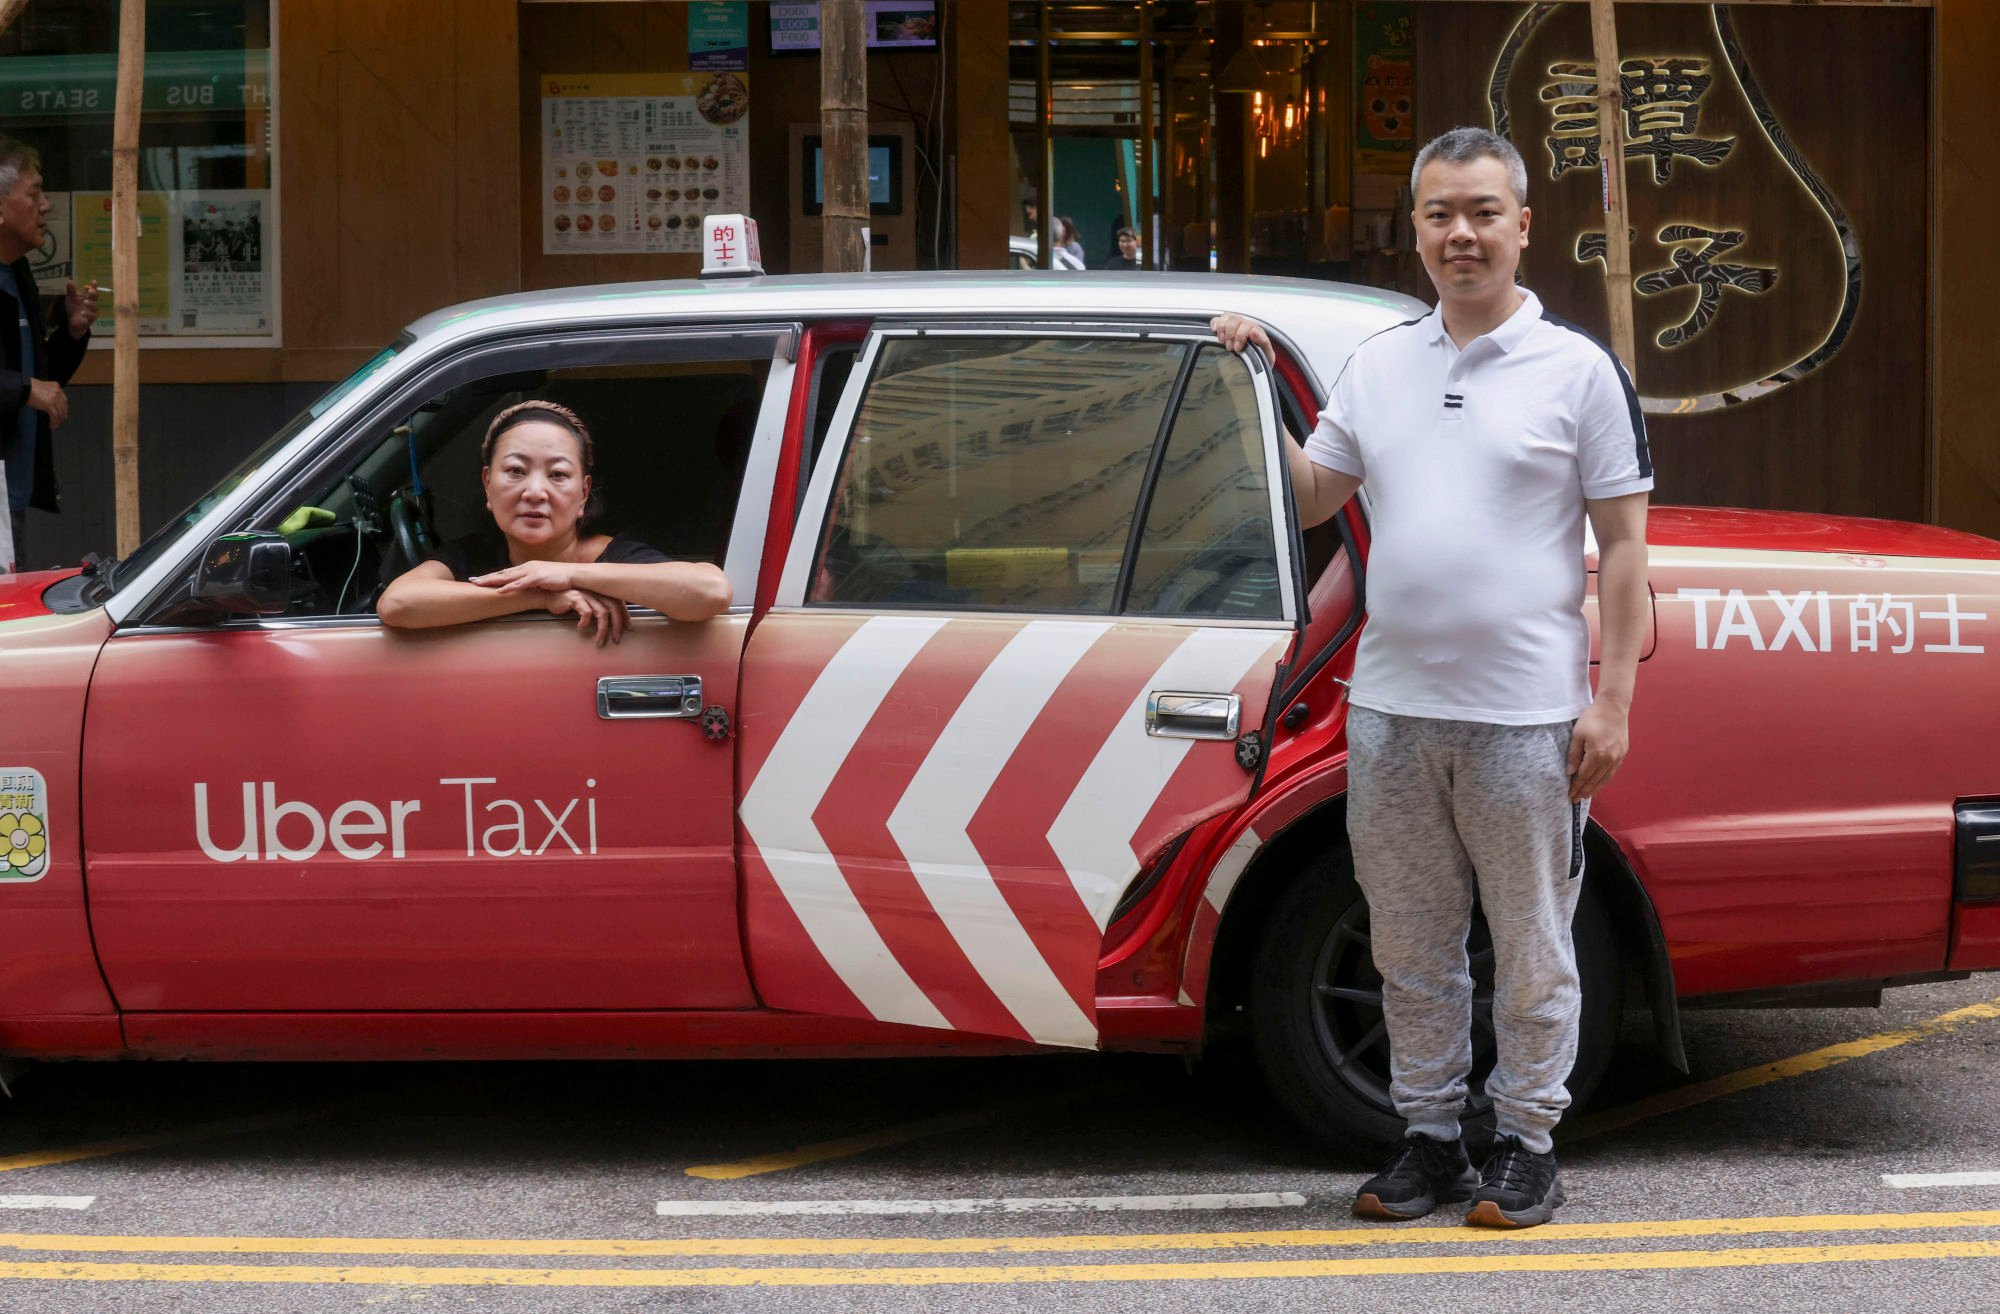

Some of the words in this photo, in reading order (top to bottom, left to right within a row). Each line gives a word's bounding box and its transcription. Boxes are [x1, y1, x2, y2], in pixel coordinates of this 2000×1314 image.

[713, 225, 736, 260] 的士
[1677, 588, 1832, 652] TAXI
[1848, 592, 1987, 654] 的士
[194, 781, 420, 863] Uber
[440, 777, 598, 858] Taxi
